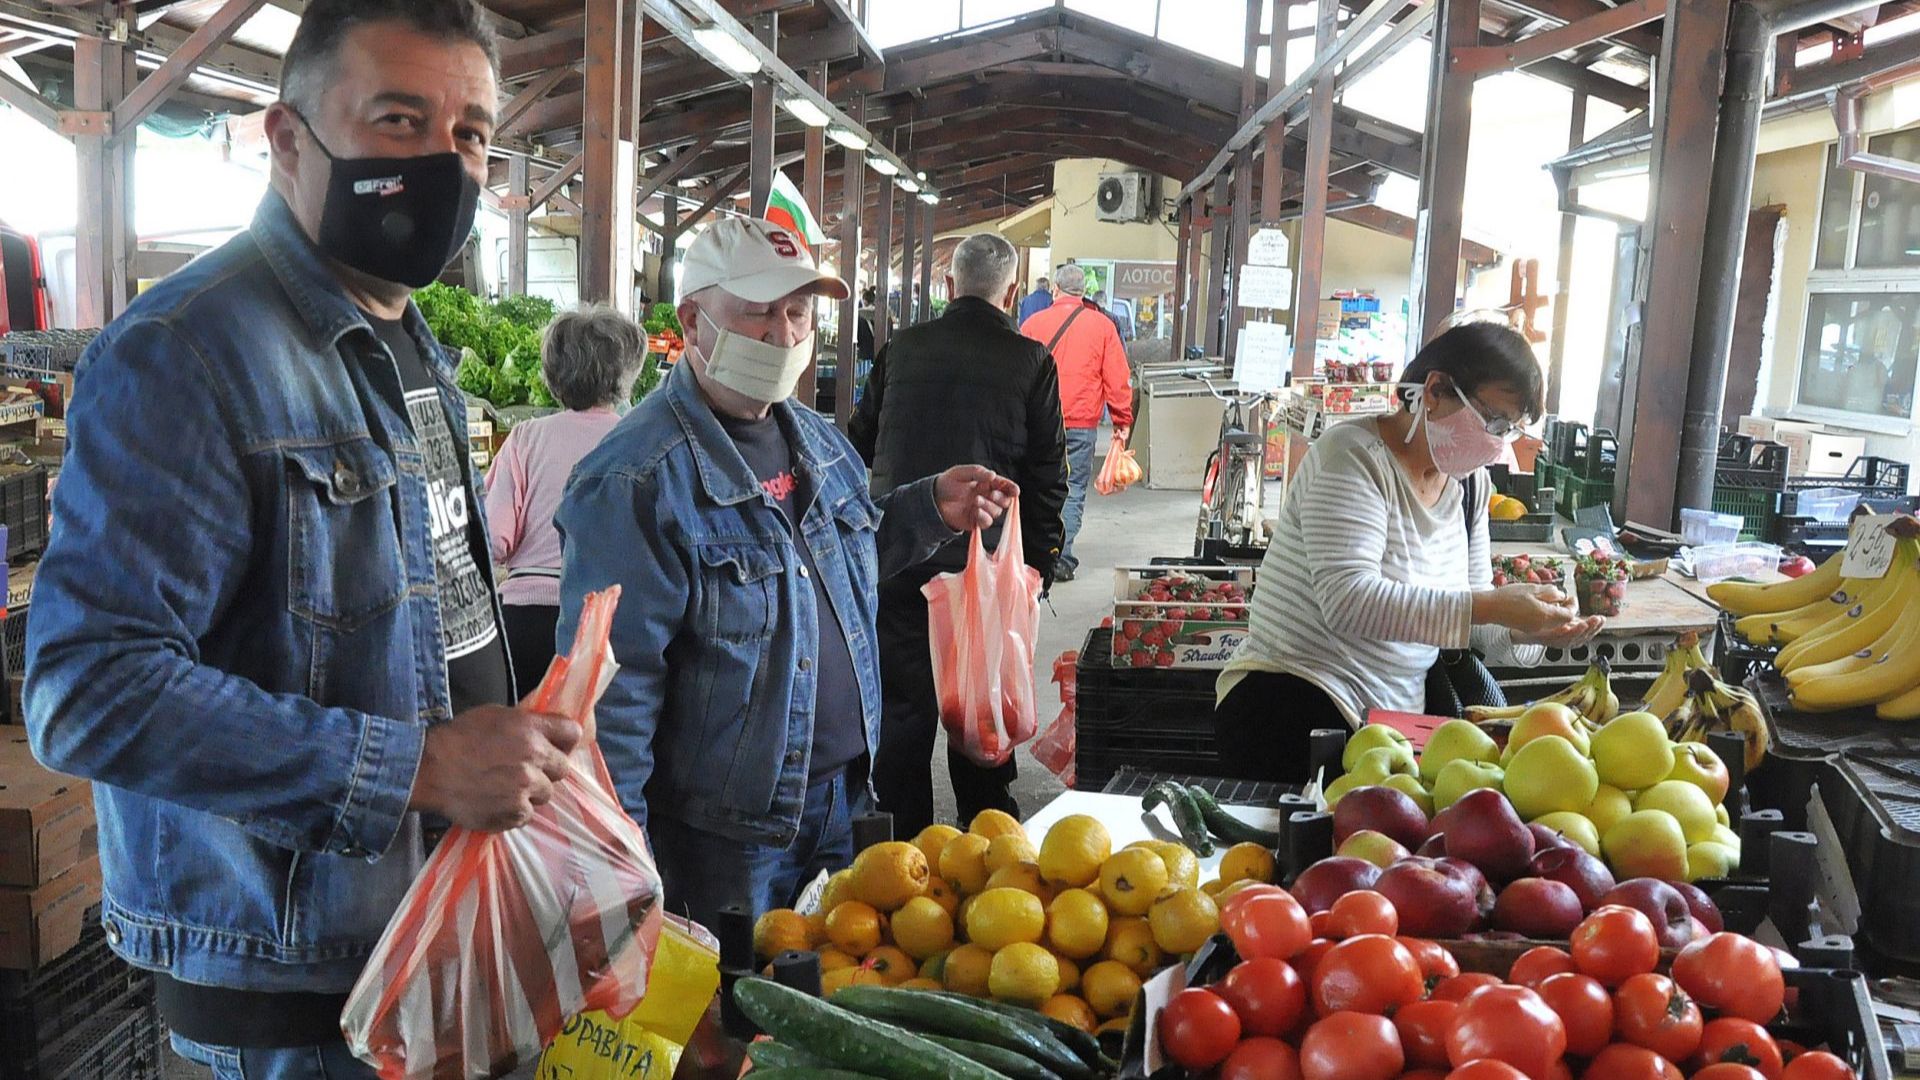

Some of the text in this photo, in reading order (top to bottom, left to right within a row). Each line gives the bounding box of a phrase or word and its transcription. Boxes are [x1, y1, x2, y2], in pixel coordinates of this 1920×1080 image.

[769, 231, 798, 257] S
[1121, 268, 1173, 285] ЛОТОС
[1219, 633, 1243, 647] Fre
[1181, 648, 1233, 663] Strawbe
